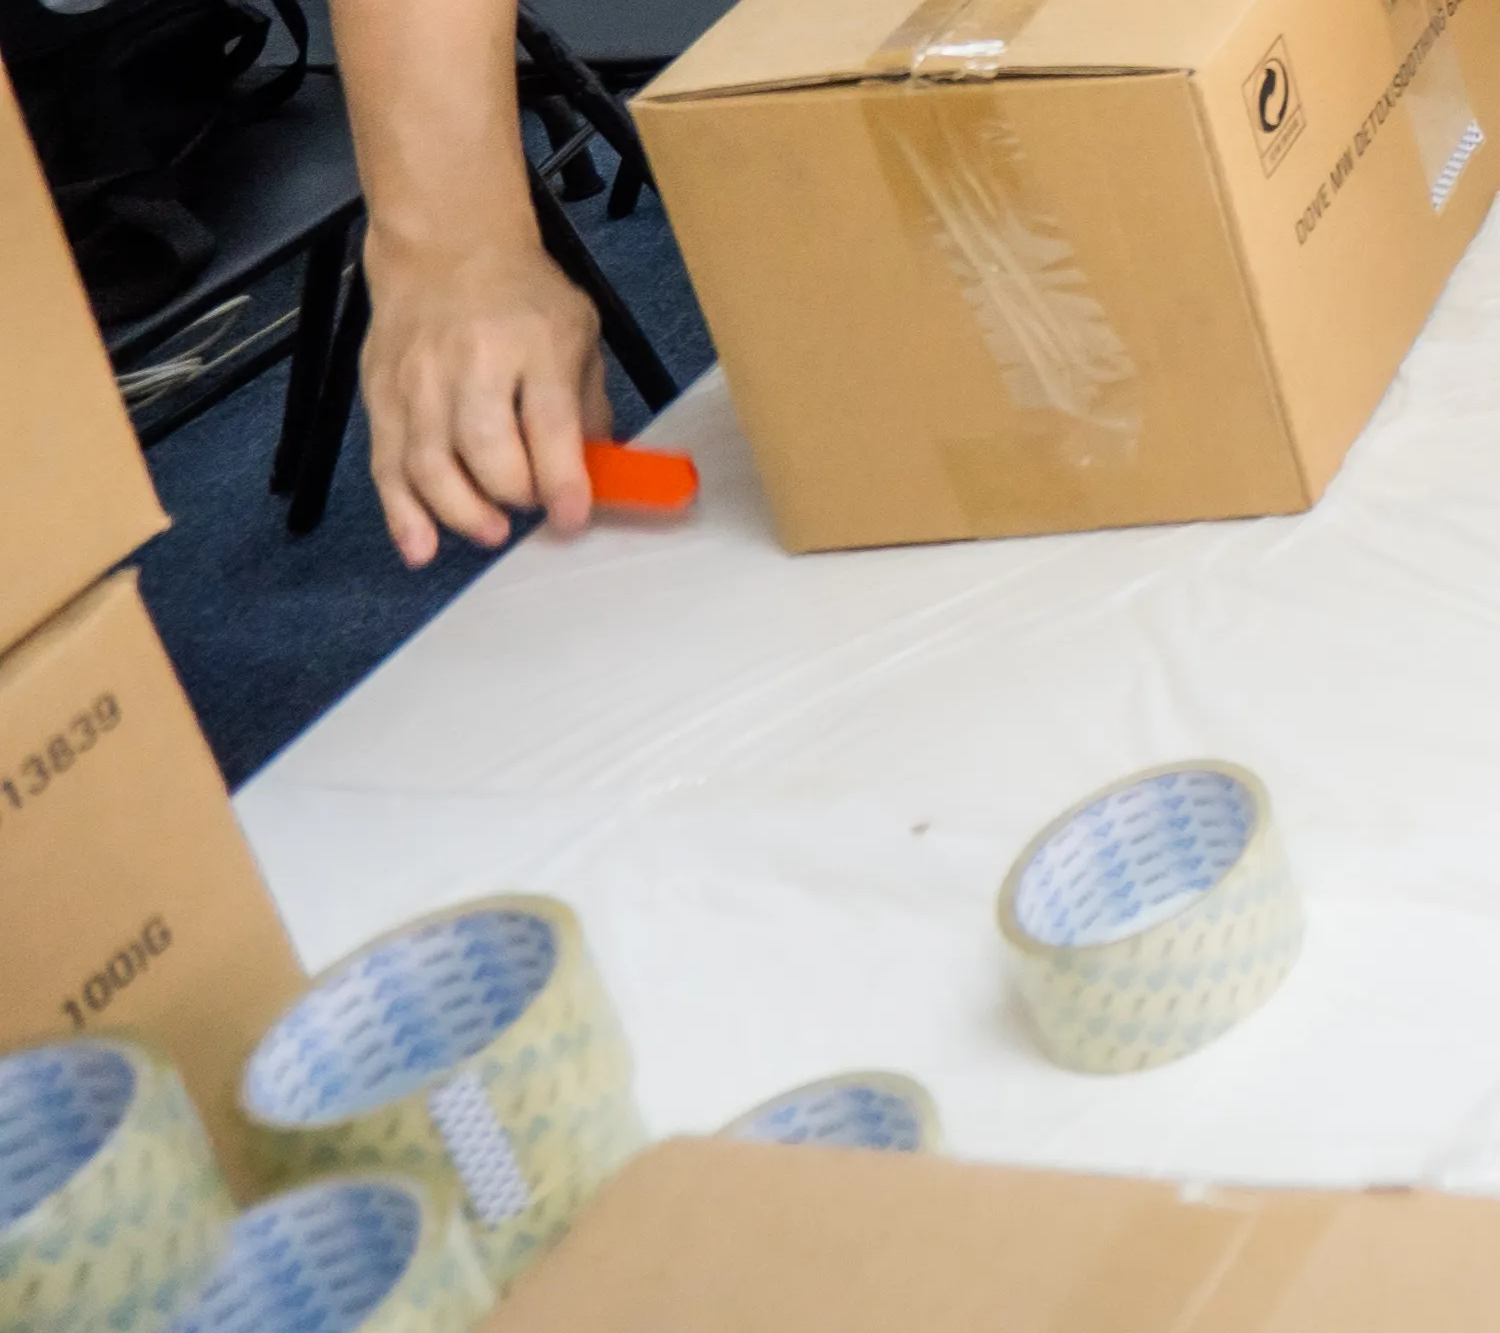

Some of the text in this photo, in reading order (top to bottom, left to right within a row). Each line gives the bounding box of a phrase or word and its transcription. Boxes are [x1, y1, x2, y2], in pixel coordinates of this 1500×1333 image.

[1297, 185, 1331, 245] DOVE
[0, 692, 124, 814] 13839
[61, 912, 172, 1032] 100)G
